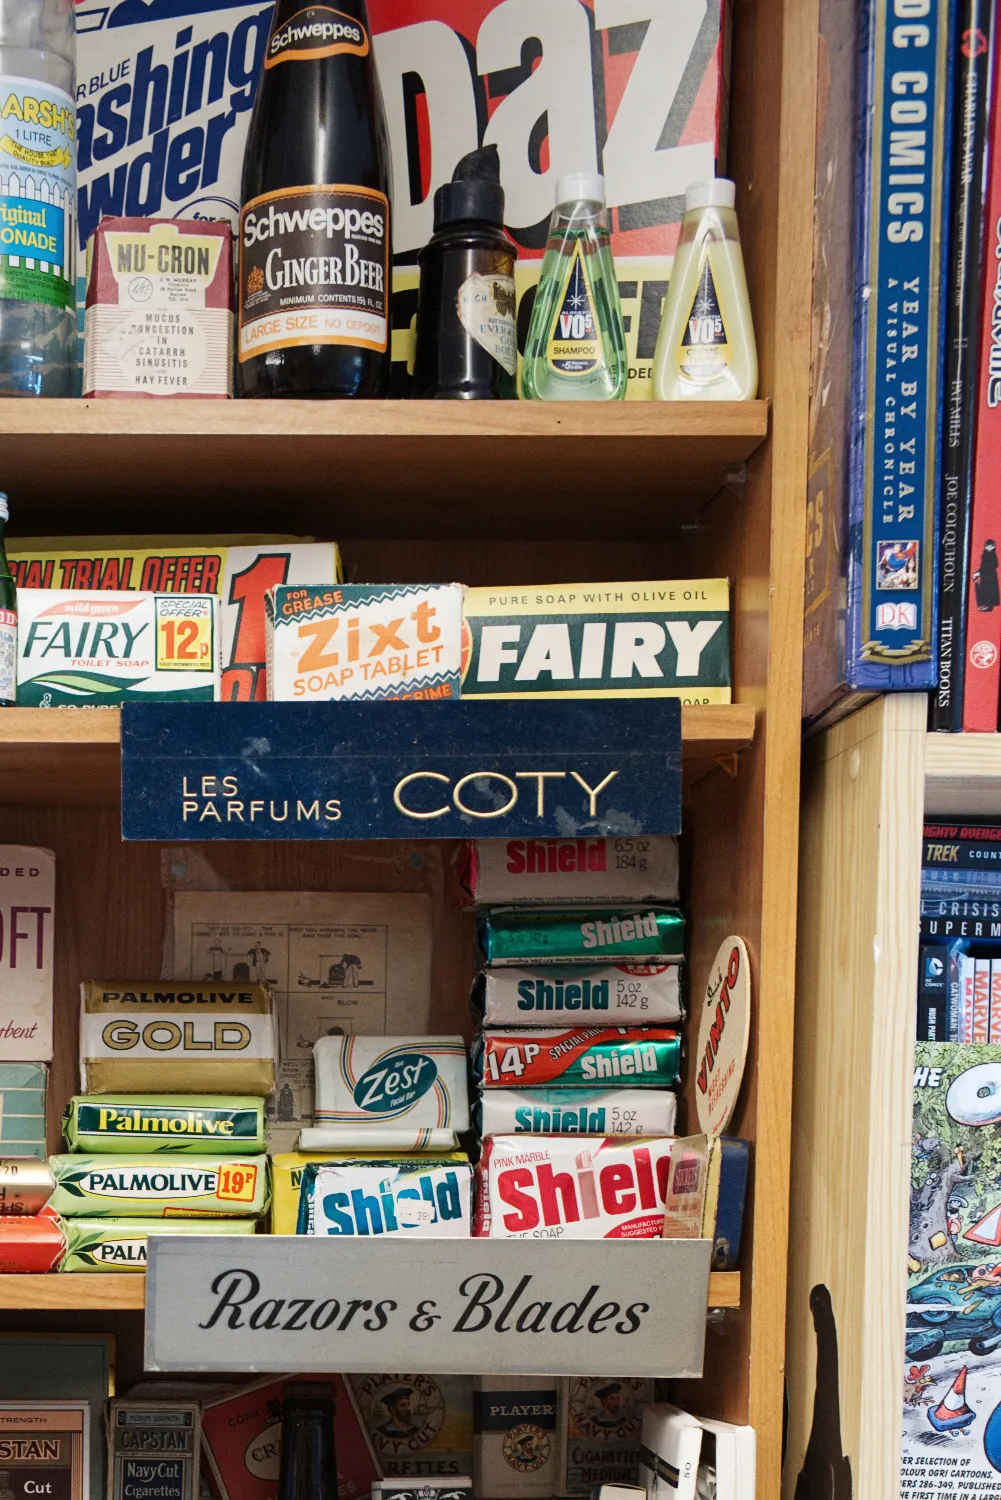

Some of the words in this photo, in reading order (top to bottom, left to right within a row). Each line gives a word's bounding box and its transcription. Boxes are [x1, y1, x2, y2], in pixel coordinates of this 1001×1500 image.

[23, 130, 52, 146] LITRE
[887, 71, 928, 243] COMICS
[244, 207, 384, 248] Schweppes
[117, 243, 210, 275] MU-CRON
[246, 321, 282, 343] LARGE
[286, 316, 318, 332] SIZE
[325, 320, 342, 329] NO
[346, 316, 381, 334] DEPOSIT
[901, 276, 920, 363] YEAR
[136, 358, 188, 368] SINUSITIS
[139, 348, 186, 357] CATARRH
[554, 347, 595, 355] SHAMPOO
[135, 375, 155, 385] HAY
[158, 376, 188, 386] FEVER
[901, 381, 917, 419] BY
[882, 397, 896, 523] CHRONICLE
[897, 439, 917, 523] YEAR
[282, 591, 343, 615] GREASE
[23, 622, 150, 658] FAIRY
[298, 600, 441, 673] Zixt
[477, 620, 722, 682] FAIRY
[941, 617, 953, 661] TITAN
[71, 659, 109, 667] TOILET
[293, 673, 354, 696] SOAP
[359, 645, 444, 679] TABLET
[939, 665, 954, 707] BOOKS
[182, 776, 238, 796] LES
[394, 771, 619, 819] COTY
[183, 800, 342, 822] PARFUMS
[927, 844, 960, 862] TREK
[103, 992, 253, 1004] PALMOLIVE
[517, 979, 609, 1011] Shield
[102, 1020, 251, 1051] GOLD
[360, 1056, 430, 1110] Zest
[99, 1109, 235, 1135] Palmolive
[89, 1173, 216, 1192] PALMOLIVE
[199, 1267, 398, 1333] Razors
[409, 1299, 441, 1333] &
[452, 1272, 649, 1336] Blades
[915, 1457, 958, 1466] SELECTION
[929, 1469, 948, 1477] OGRI
[951, 1471, 993, 1479] CARTOONS,
[23, 1481, 52, 1494] Cut
